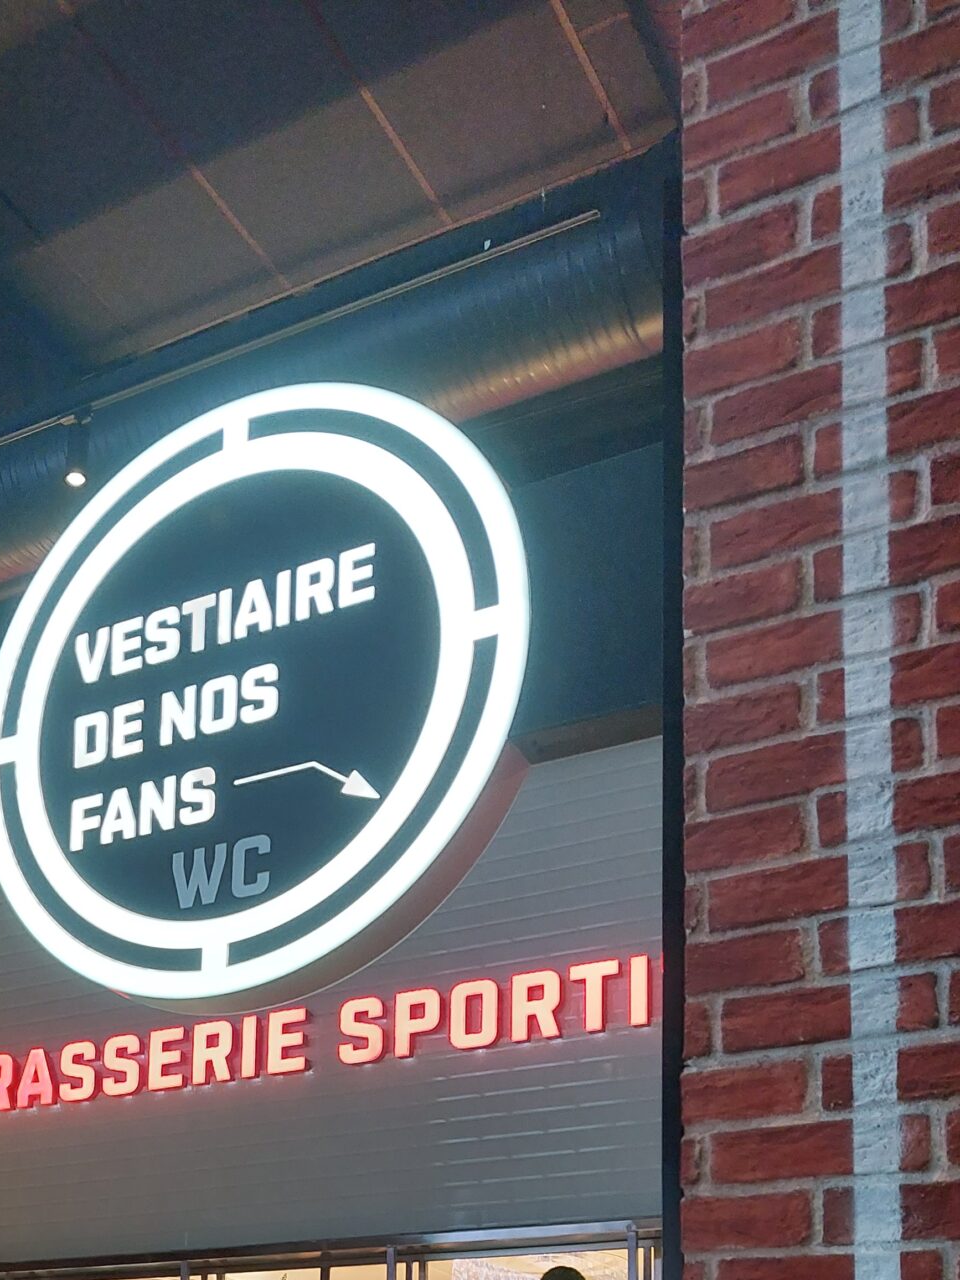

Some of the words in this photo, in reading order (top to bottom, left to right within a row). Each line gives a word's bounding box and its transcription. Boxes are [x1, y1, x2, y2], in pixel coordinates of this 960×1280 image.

[74, 542, 377, 684] VESTIAIRE
[72, 699, 145, 770] DE
[158, 662, 280, 747] NOS
[68, 766, 217, 852] FANS
[171, 834, 272, 909] WC
[336, 952, 664, 1066] SPORTI
